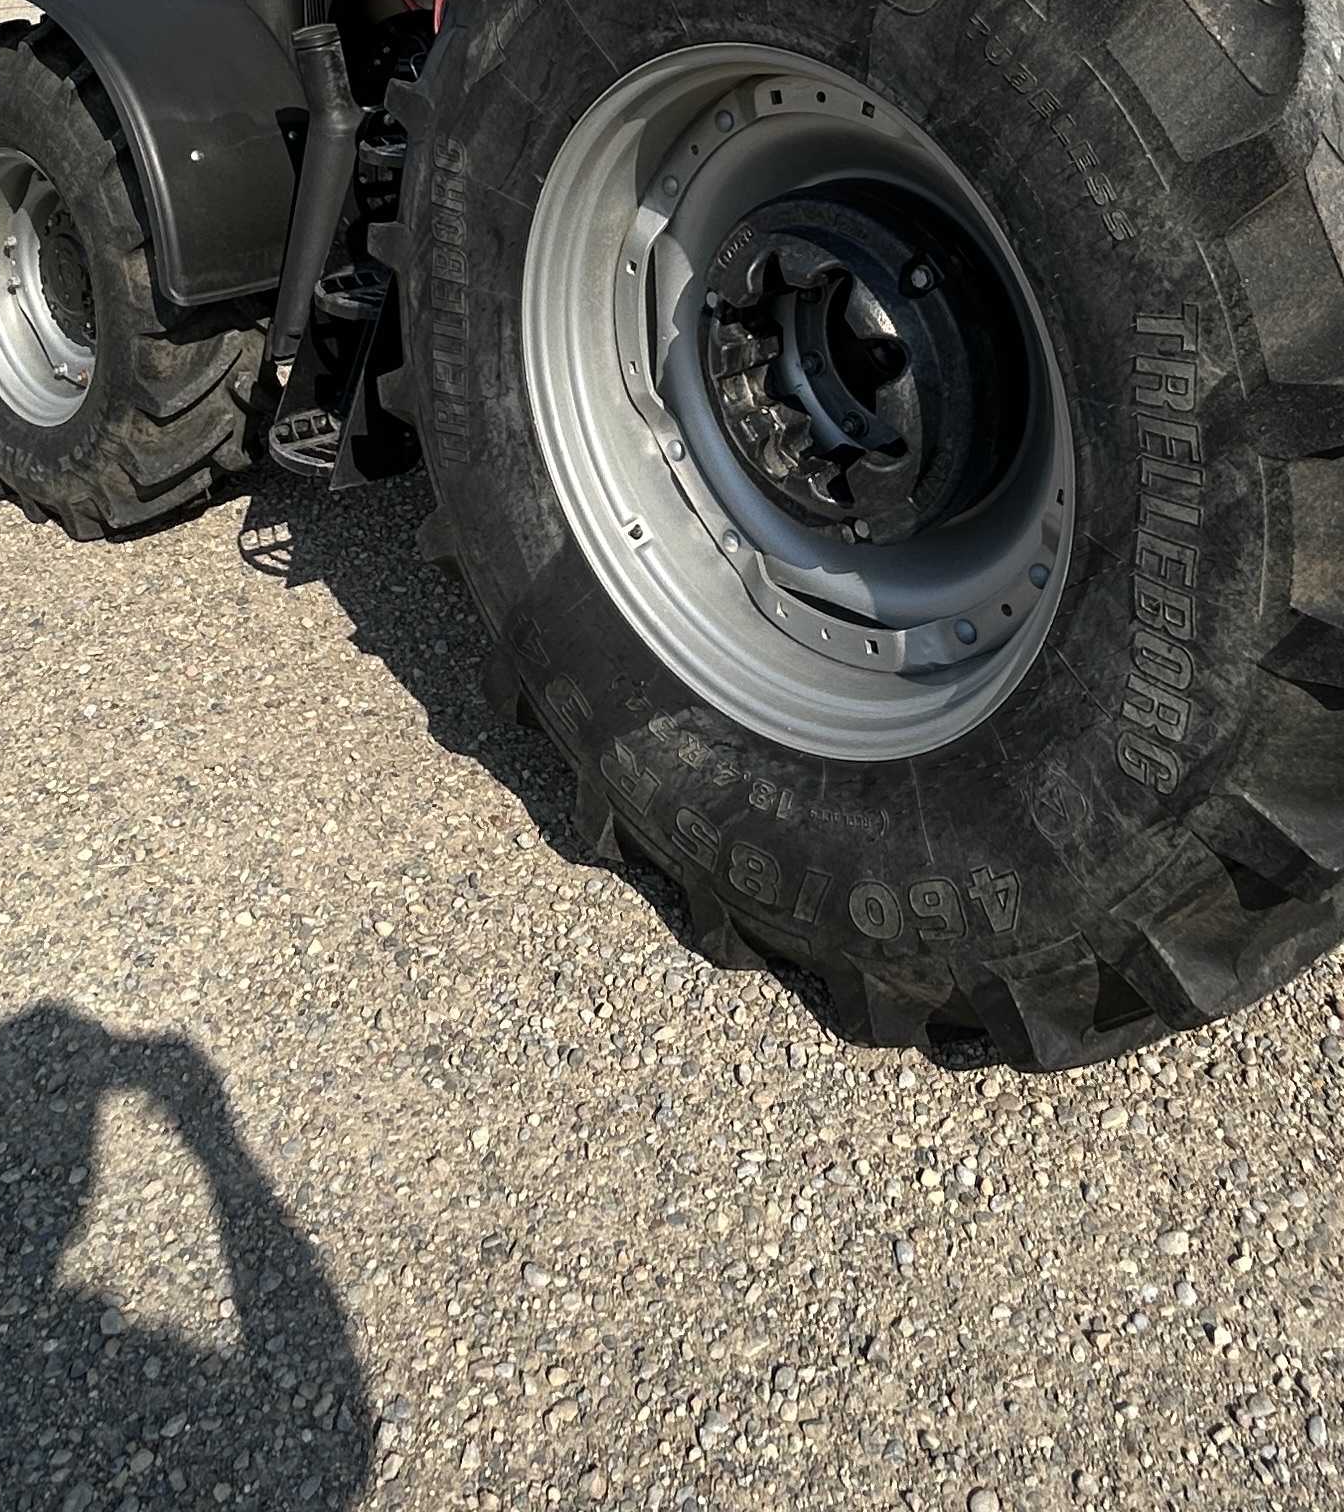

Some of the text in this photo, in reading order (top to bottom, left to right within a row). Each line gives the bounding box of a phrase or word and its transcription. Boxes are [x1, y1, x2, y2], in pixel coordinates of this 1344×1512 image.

[965, 12, 1138, 243] TUBELESS
[430, 131, 471, 470] TRELLEBORG
[1114, 302, 1204, 796] TRELLEBORG
